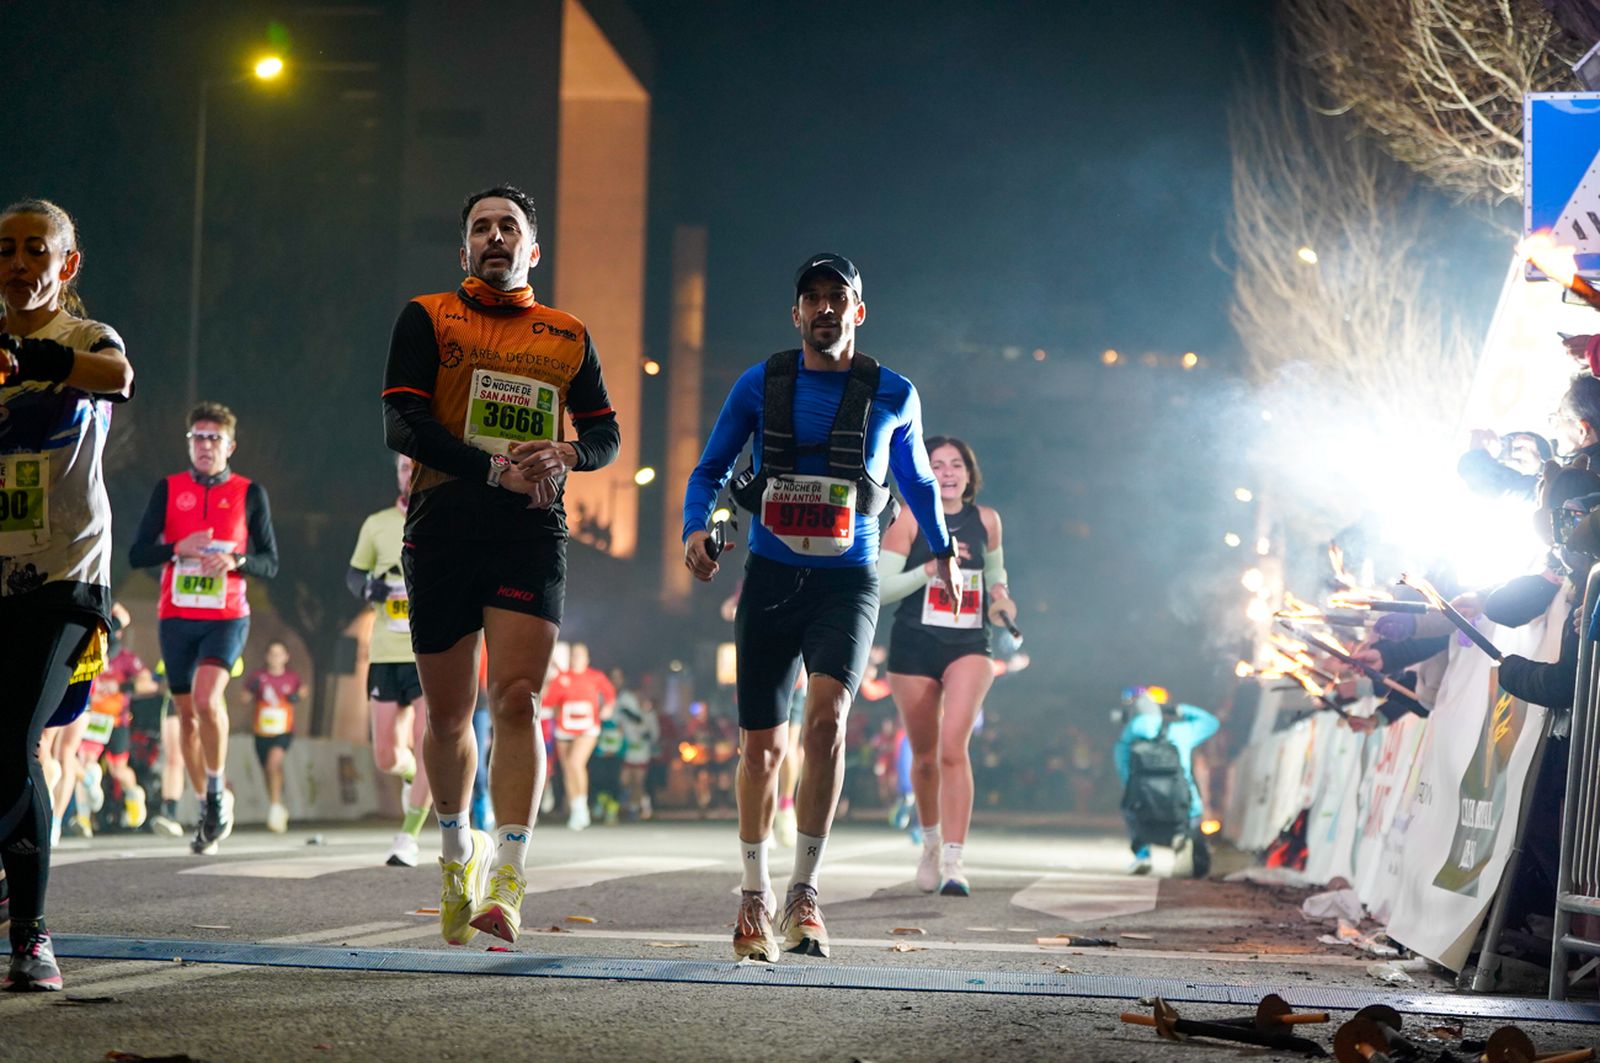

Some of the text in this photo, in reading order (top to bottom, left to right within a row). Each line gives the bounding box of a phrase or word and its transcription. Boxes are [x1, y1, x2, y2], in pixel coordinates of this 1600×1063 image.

[492, 382, 520, 394] NOCHE
[521, 387, 532, 396] DE
[480, 390, 498, 401] SAN
[499, 394, 531, 407] ANTÓN
[483, 401, 544, 436] 3668
[783, 483, 810, 492] NOCHE
[811, 483, 822, 493] DE
[773, 493, 790, 502] SAN
[791, 491, 822, 503] ANTÓN
[780, 504, 837, 528] 9758
